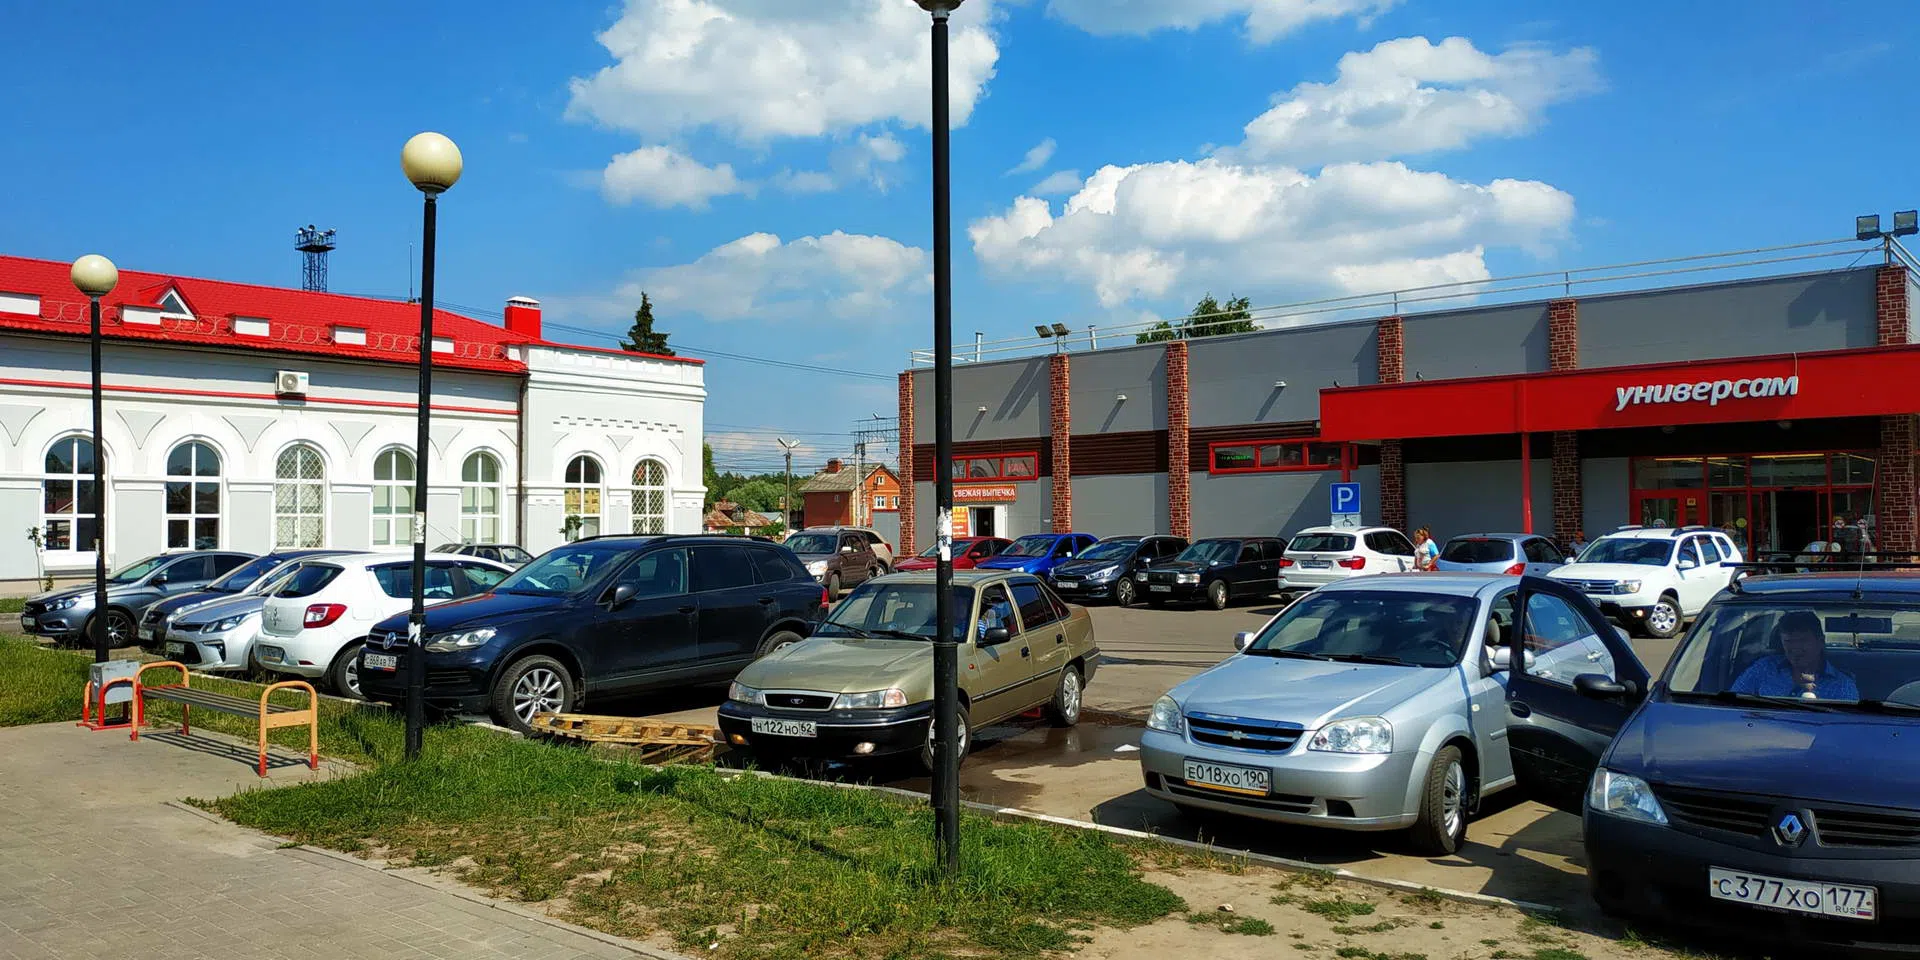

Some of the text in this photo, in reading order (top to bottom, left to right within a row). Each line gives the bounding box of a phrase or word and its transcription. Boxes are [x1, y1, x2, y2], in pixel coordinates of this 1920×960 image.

[1616, 376, 1799, 411] универсам
[953, 488, 1015, 498] СВЕЖАЯ ВЫПЕЧКА
[1337, 487, 1354, 511] P
[1835, 905, 1856, 915] RUS
